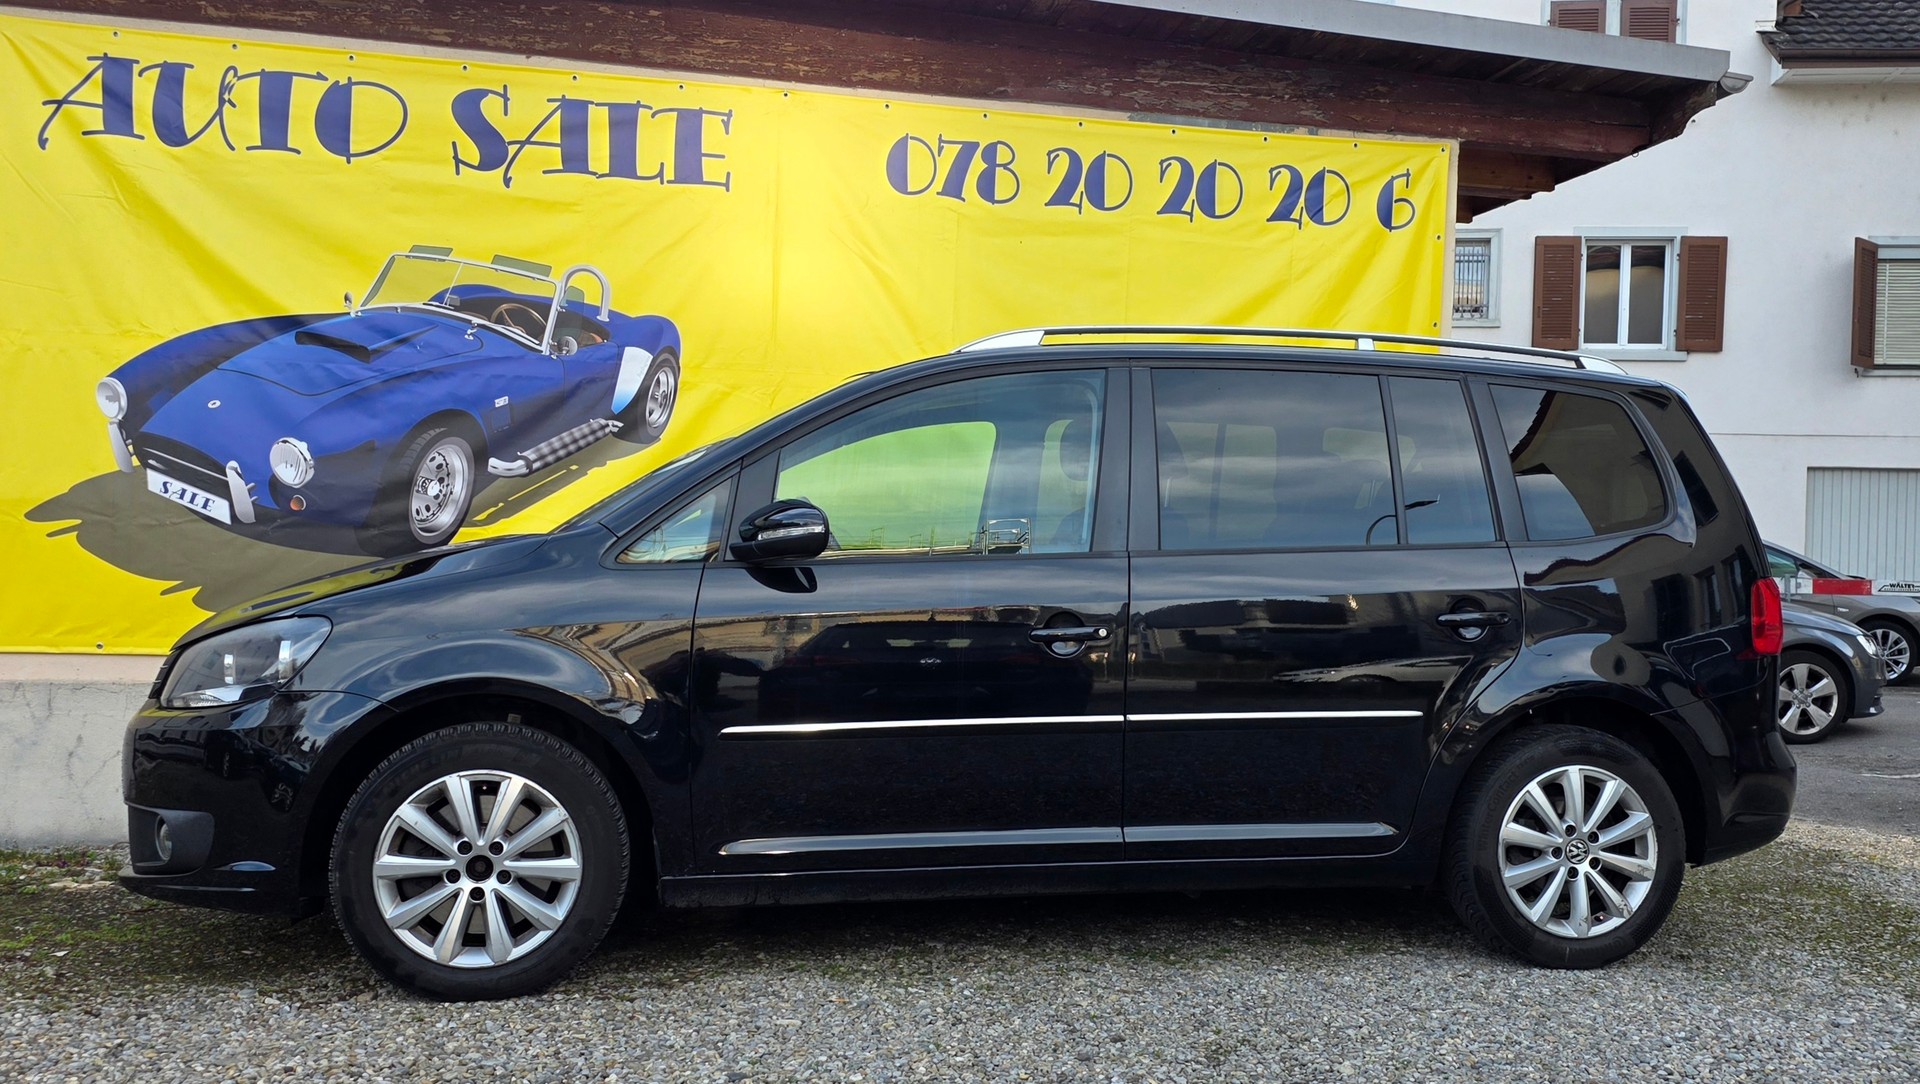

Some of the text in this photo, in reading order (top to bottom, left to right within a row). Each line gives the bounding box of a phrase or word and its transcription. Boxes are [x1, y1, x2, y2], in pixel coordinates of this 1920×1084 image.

[38, 53, 733, 191] AUTO SALE
[885, 132, 1416, 233] 078 20 20 20 6
[159, 481, 216, 512] SALE
